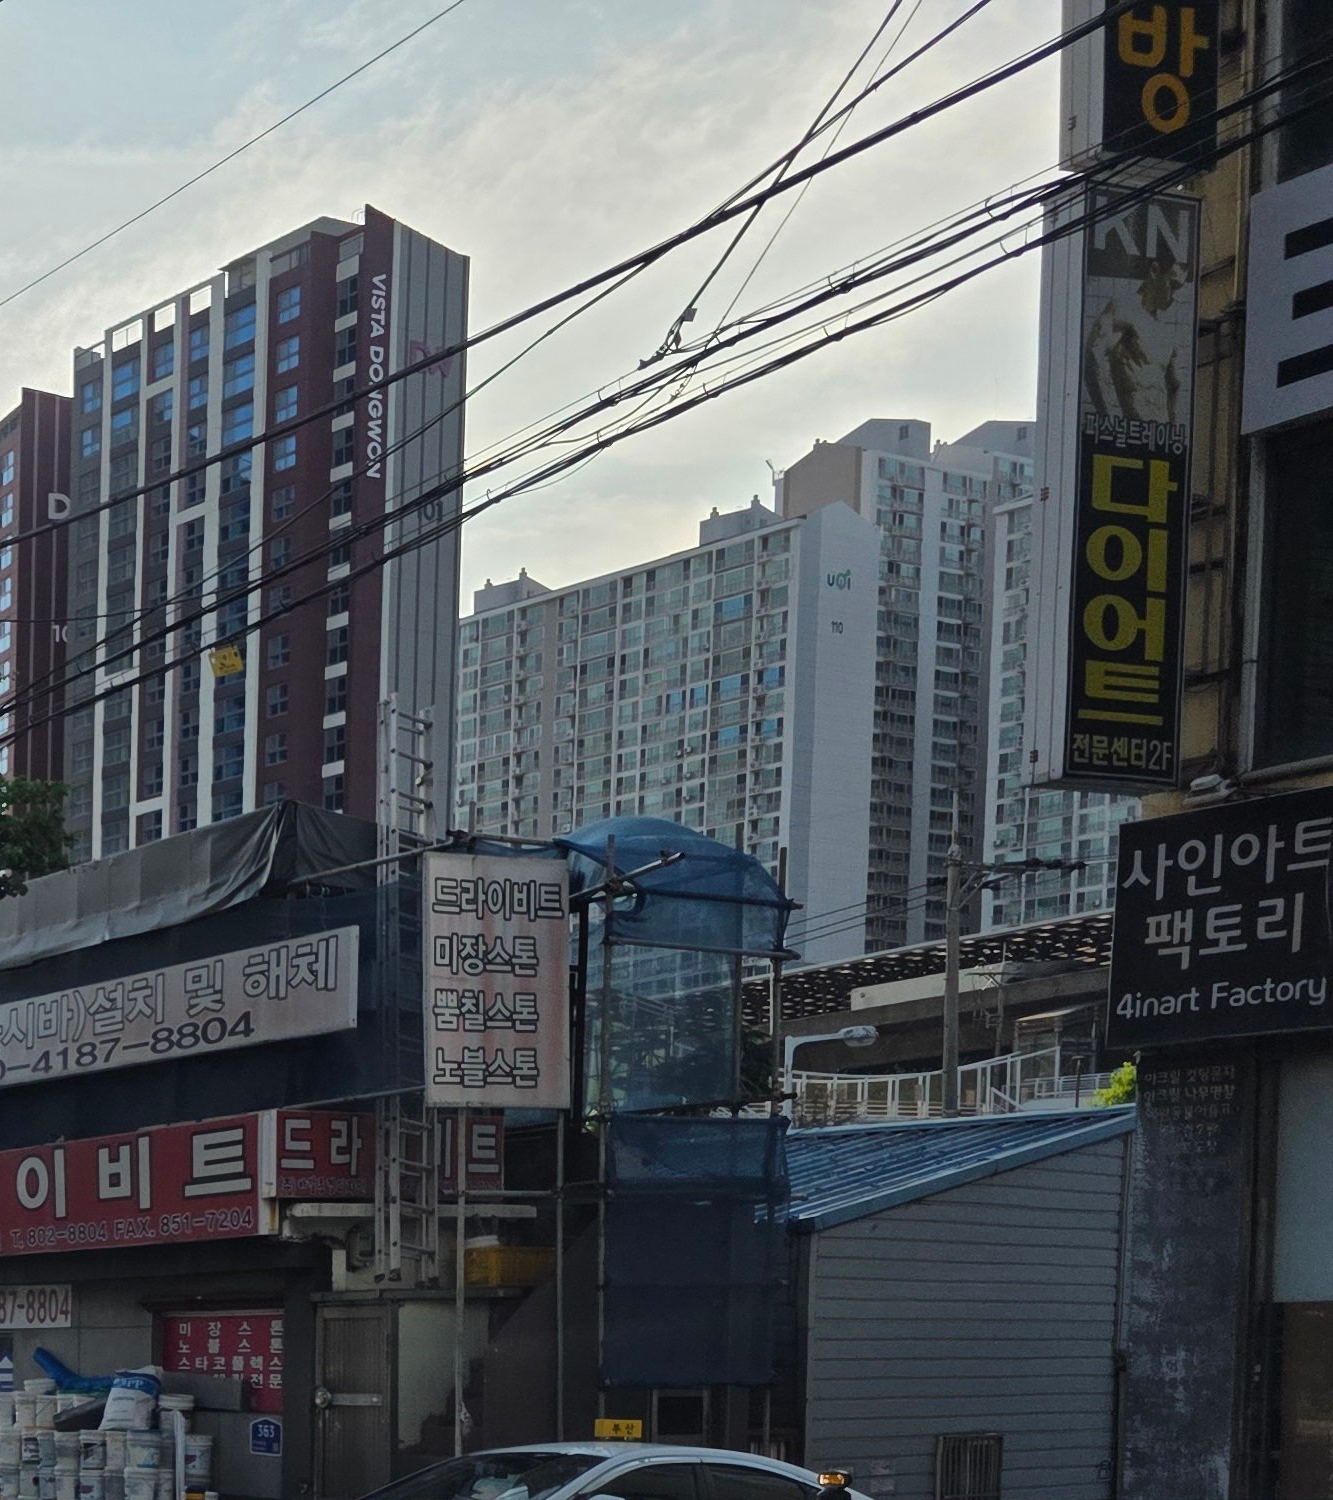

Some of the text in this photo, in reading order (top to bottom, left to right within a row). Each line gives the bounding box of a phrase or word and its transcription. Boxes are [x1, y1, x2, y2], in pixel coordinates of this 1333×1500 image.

[369, 273, 387, 338] VISTA
[1085, 412, 1187, 456] 퍼스널트레이닝
[1077, 453, 1179, 727] 다이어트
[1121, 816, 1333, 901] 사인아트
[433, 876, 565, 922] 드라이비트
[434, 932, 539, 977] 미장스톤
[1144, 891, 1305, 971] 팩토리
[184, 959, 225, 1017] 및
[241, 934, 340, 1001] 해체
[1116, 976, 1327, 1019] 4inart Factory
[433, 987, 539, 1034] 뿜칠스톤
[433, 1046, 540, 1089] 노블스톤
